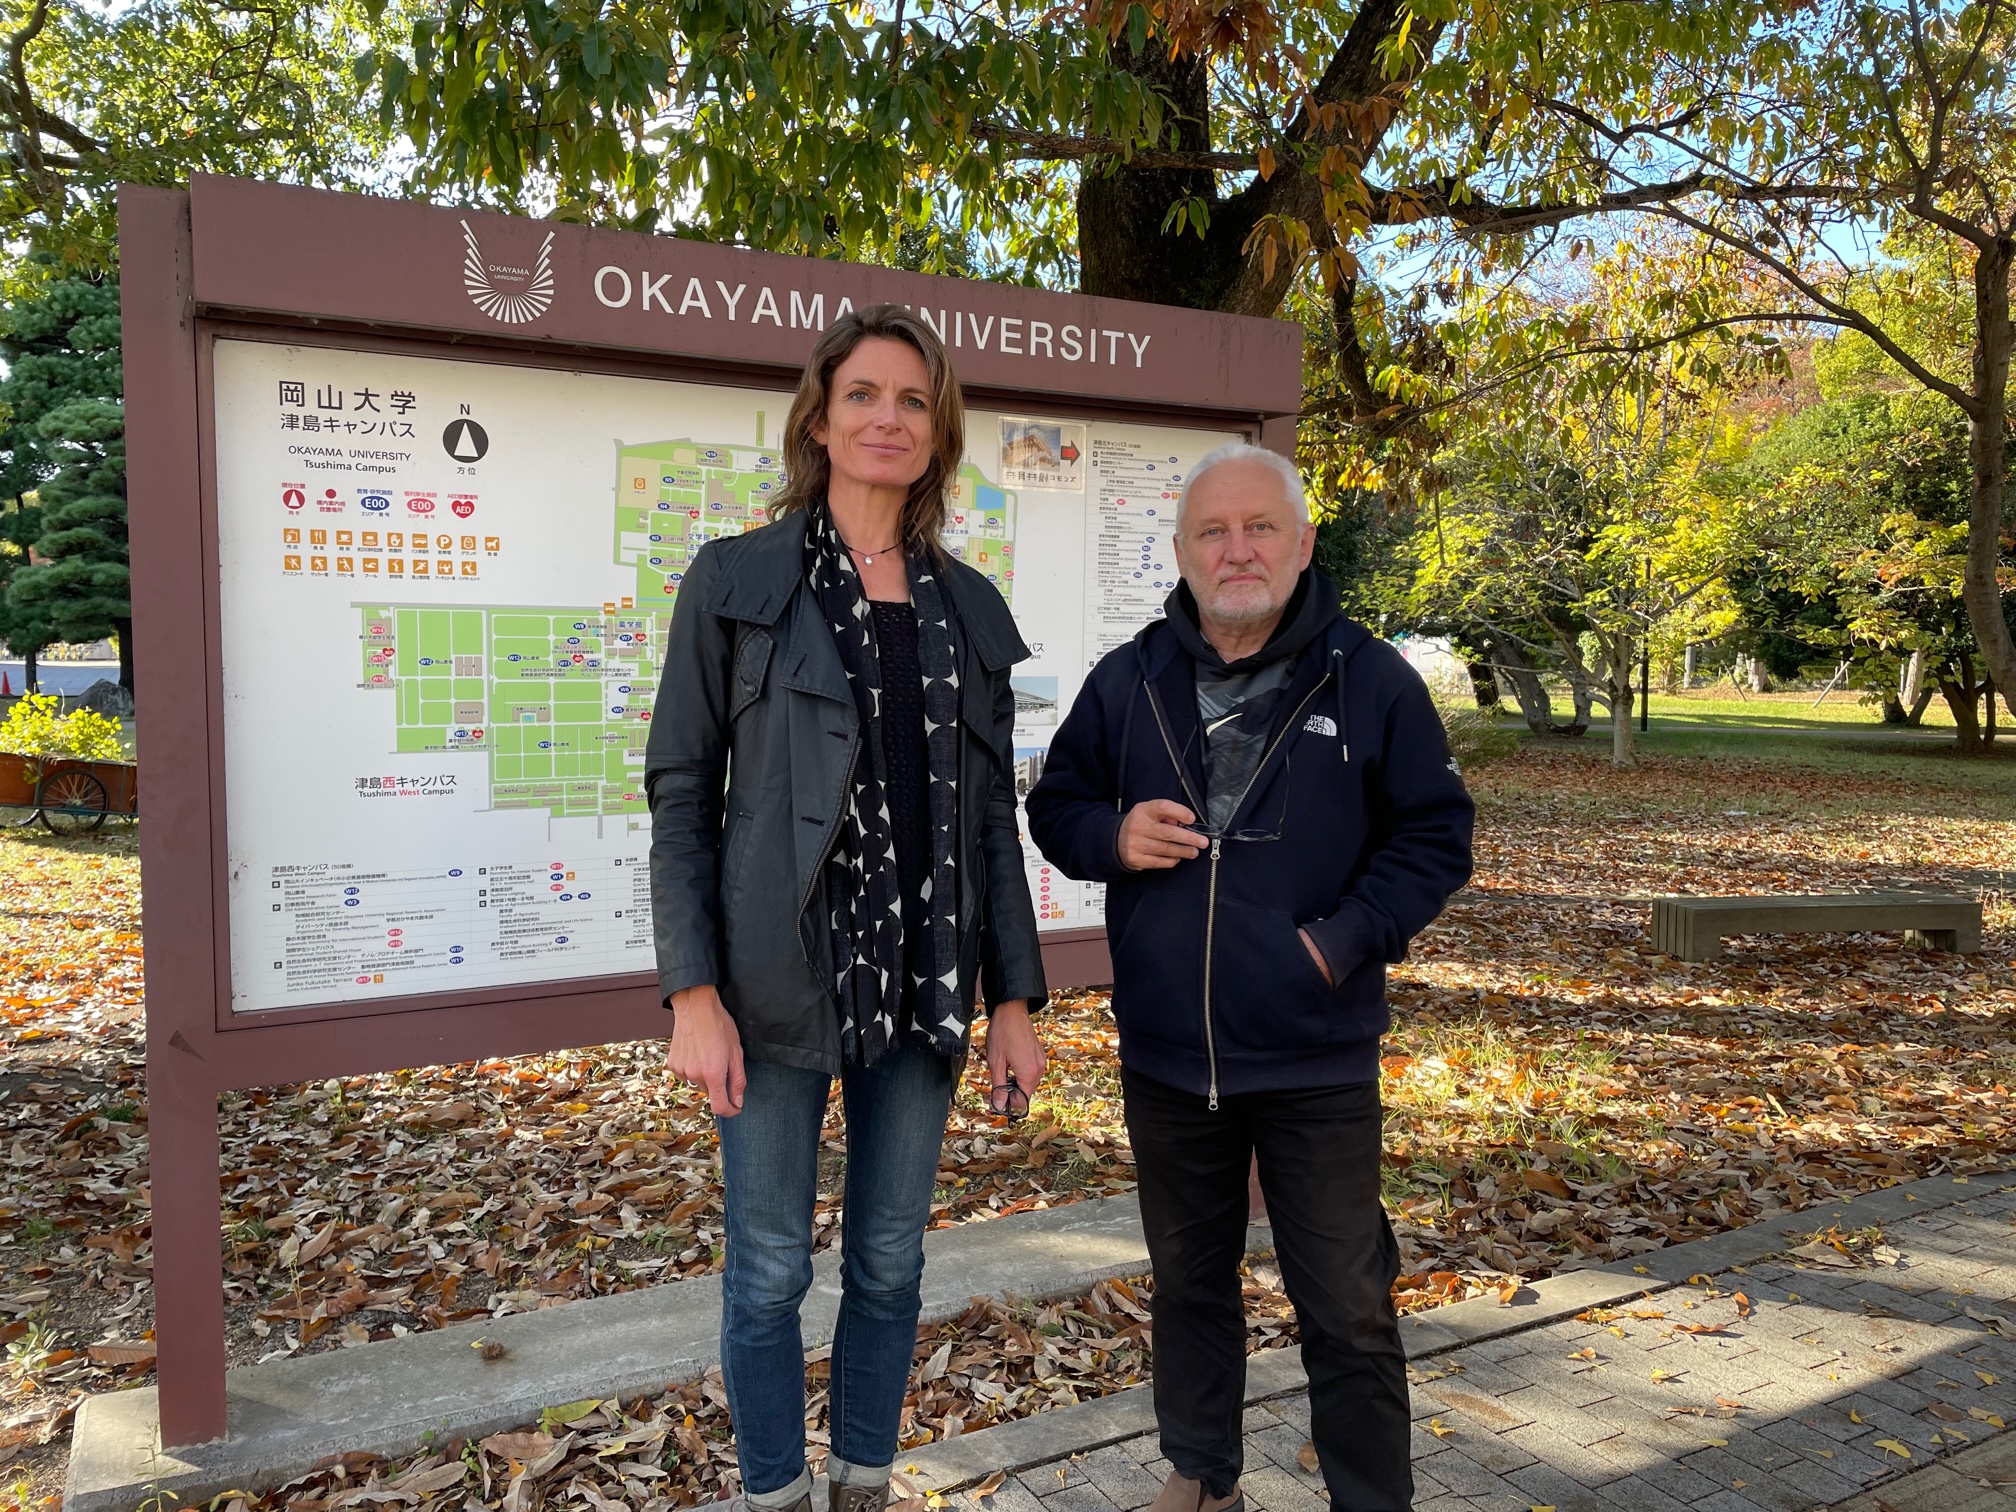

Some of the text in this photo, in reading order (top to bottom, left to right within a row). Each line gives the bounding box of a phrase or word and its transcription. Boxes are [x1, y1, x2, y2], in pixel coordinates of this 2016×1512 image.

[489, 264, 530, 276] OKAYAMA
[494, 274, 525, 282] UNIVERSITY
[885, 302, 1151, 368] NIVERSITY
[279, 380, 416, 415] 岡山大学
[460, 404, 470, 415] N
[281, 413, 416, 438] 津島キャンパス
[288, 445, 411, 461] OKAYAMA UNIVERSITY
[304, 459, 396, 474] Tsushima Campus
[456, 467, 476, 475] 方位
[365, 498, 385, 508] E00
[411, 501, 431, 511] E00
[456, 506, 471, 514] AED
[1303, 725, 1322, 734] FACE
[355, 774, 457, 790] 津島西キャンパス
[359, 790, 397, 798] Tsushima
[422, 788, 454, 798] Campus
[272, 863, 329, 873] 津島西キャンパス
